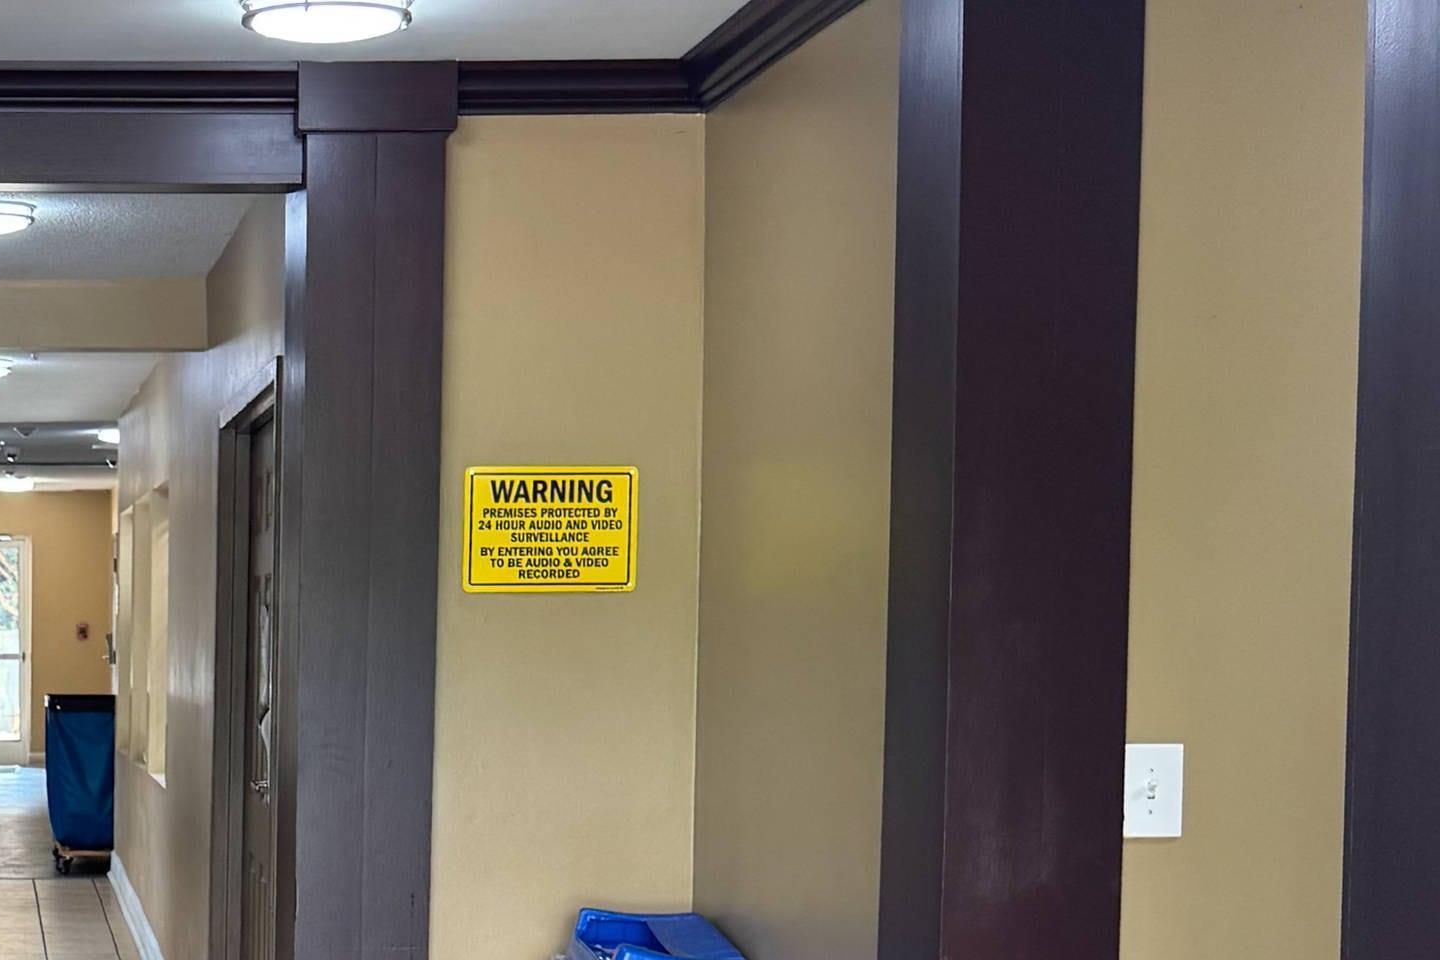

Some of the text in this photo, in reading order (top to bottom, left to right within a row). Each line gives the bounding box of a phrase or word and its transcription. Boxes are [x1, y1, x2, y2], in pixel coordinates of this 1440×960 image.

[491, 480, 612, 503] WARNING
[483, 508, 618, 518] PREMISES PROTECTED BY
[479, 520, 622, 530] 24 HOUR AUDIO AND VIDEO
[511, 532, 589, 542] SURVEILLANCE
[480, 547, 619, 556] BY ENTERING YOU AGREE
[491, 558, 608, 567] TO BE AUDIO & VIDEO
[519, 570, 580, 579] RECORDED
